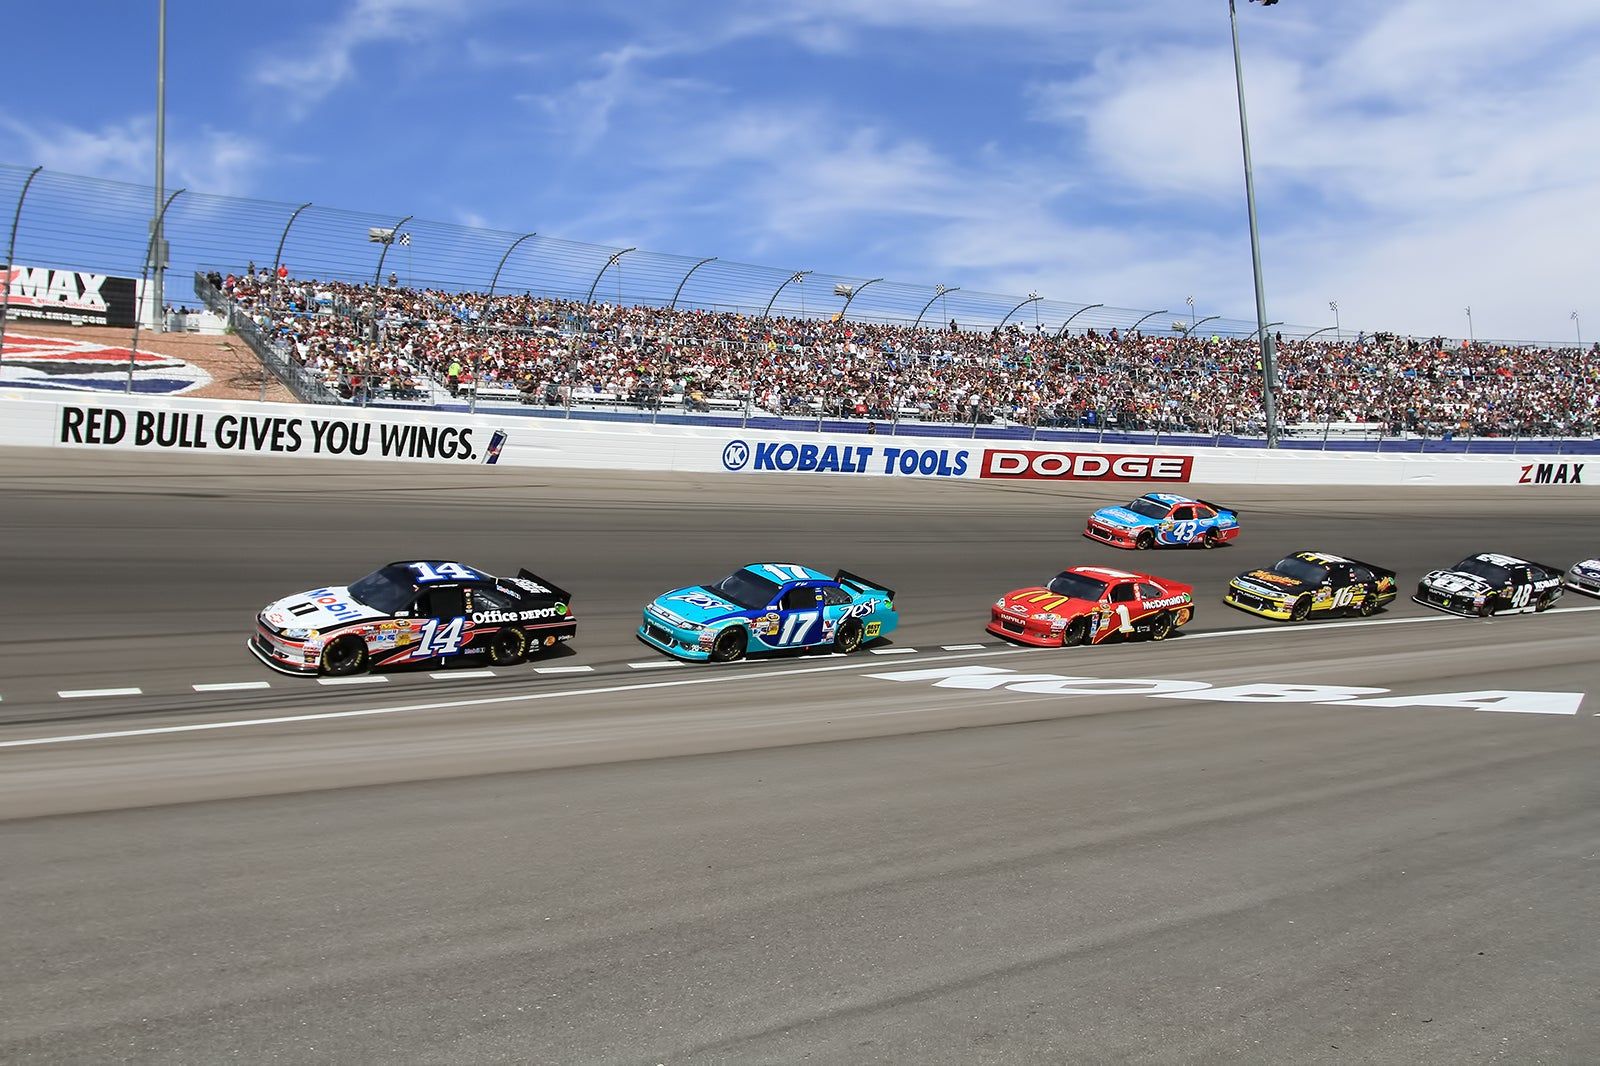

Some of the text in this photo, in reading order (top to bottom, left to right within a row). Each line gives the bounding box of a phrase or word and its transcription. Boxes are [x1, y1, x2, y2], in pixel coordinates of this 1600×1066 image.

[61, 406, 477, 460] RED BULL GIVES YOU WINGS.
[754, 442, 969, 477] KOBALT TOOLS
[990, 452, 1184, 478] DODGE
[1173, 522, 1197, 540] 43
[410, 562, 478, 581] 14
[304, 589, 362, 621] Mobil
[1142, 596, 1185, 610] McDonald's
[1330, 585, 1354, 610] 16
[1511, 583, 1533, 608] 48
[472, 607, 556, 624] Office DEPOT
[778, 611, 820, 645] 17
[1115, 604, 1135, 633] 1
[411, 617, 464, 657] 14
[859, 665, 1600, 716] KOBA
